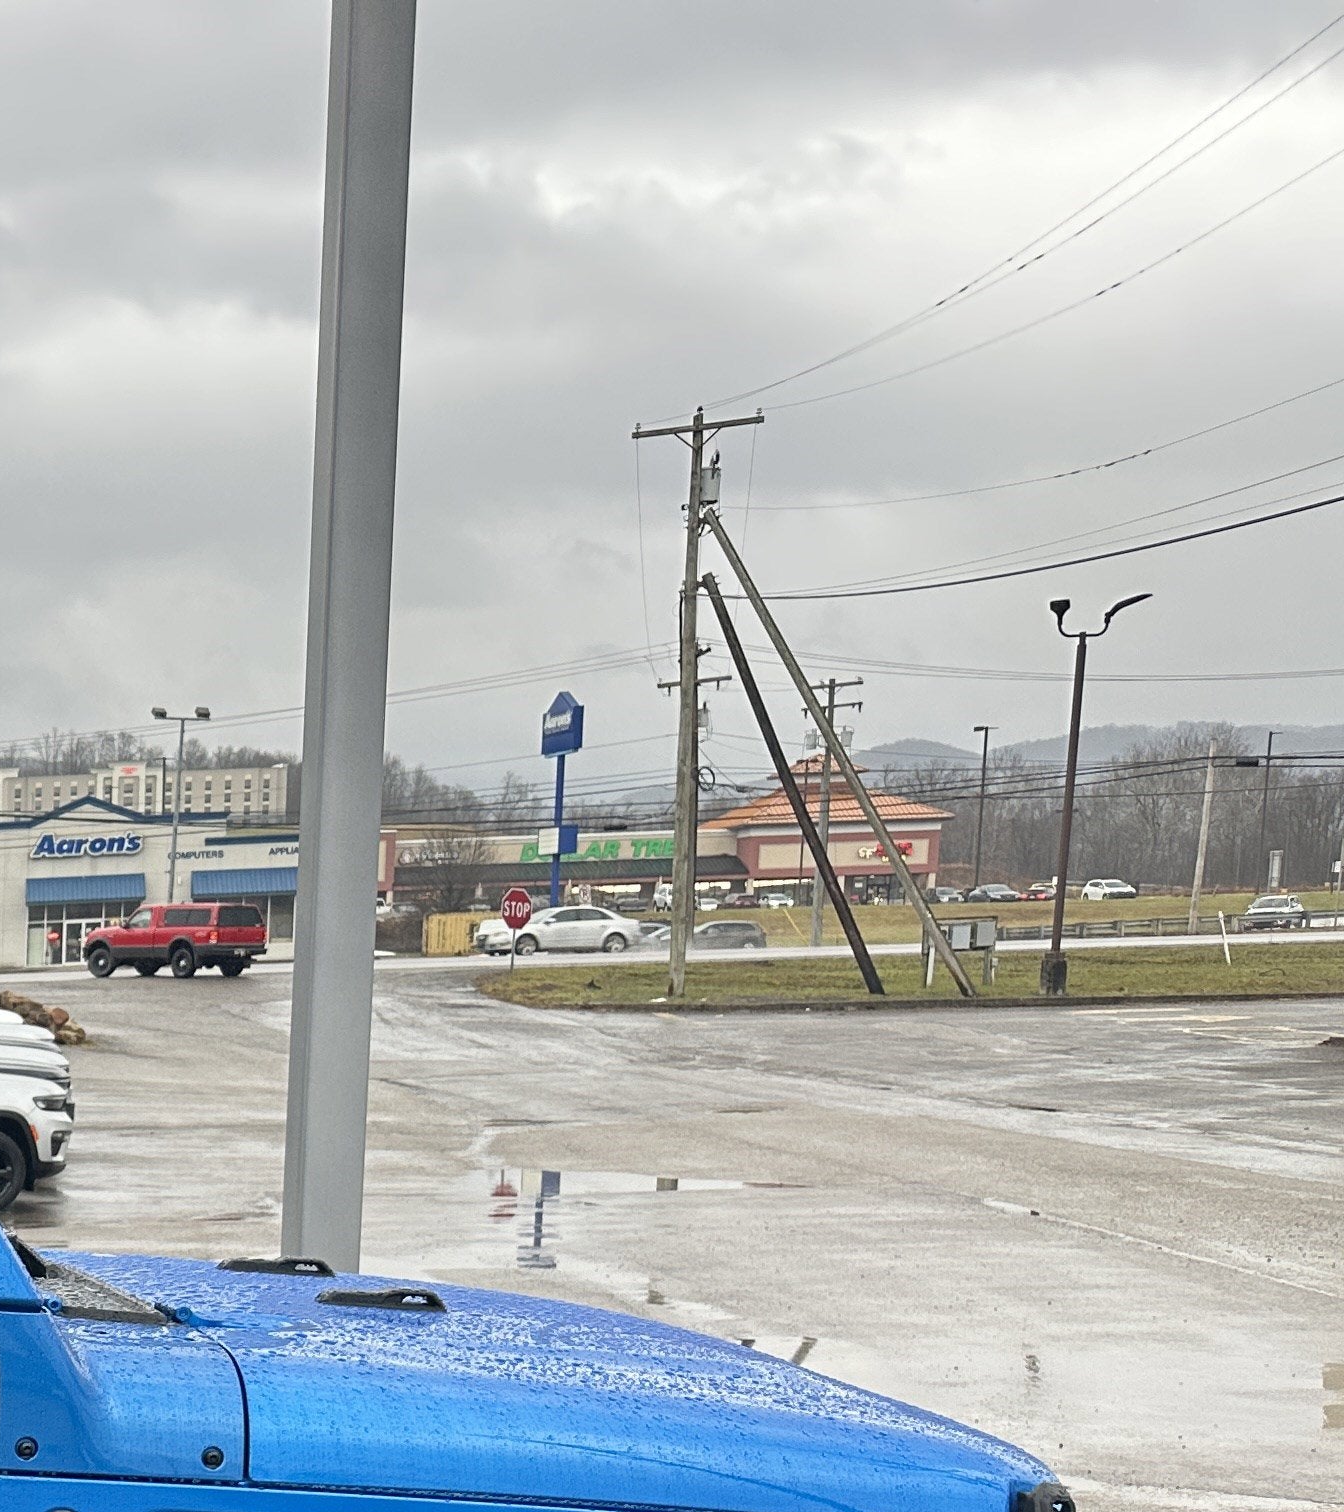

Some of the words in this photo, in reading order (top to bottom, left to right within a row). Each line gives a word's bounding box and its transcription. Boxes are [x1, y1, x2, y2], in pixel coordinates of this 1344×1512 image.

[30, 831, 143, 858] Aaron's
[269, 846, 299, 857] APPLIA
[520, 839, 621, 862] DAR
[631, 838, 675, 858] TRE
[168, 849, 225, 861] COMPUTERS
[503, 900, 531, 918] STOP
